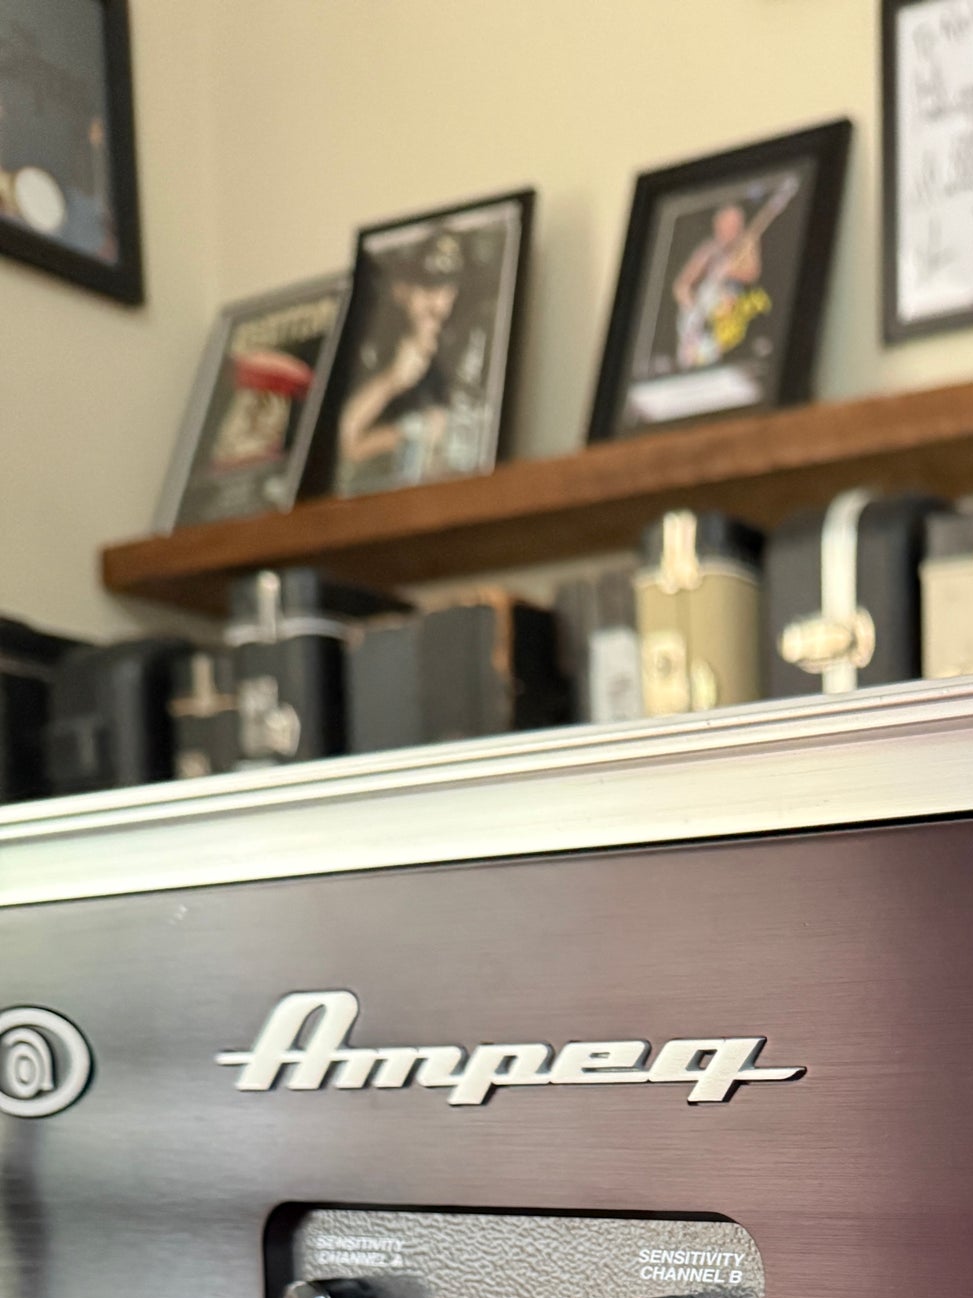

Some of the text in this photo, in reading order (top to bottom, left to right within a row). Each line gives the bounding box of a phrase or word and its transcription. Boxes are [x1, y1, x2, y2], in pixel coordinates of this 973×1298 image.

[639, 1249, 746, 1267] SENSITIVITY
[640, 1265, 743, 1285] CHANNEL B
